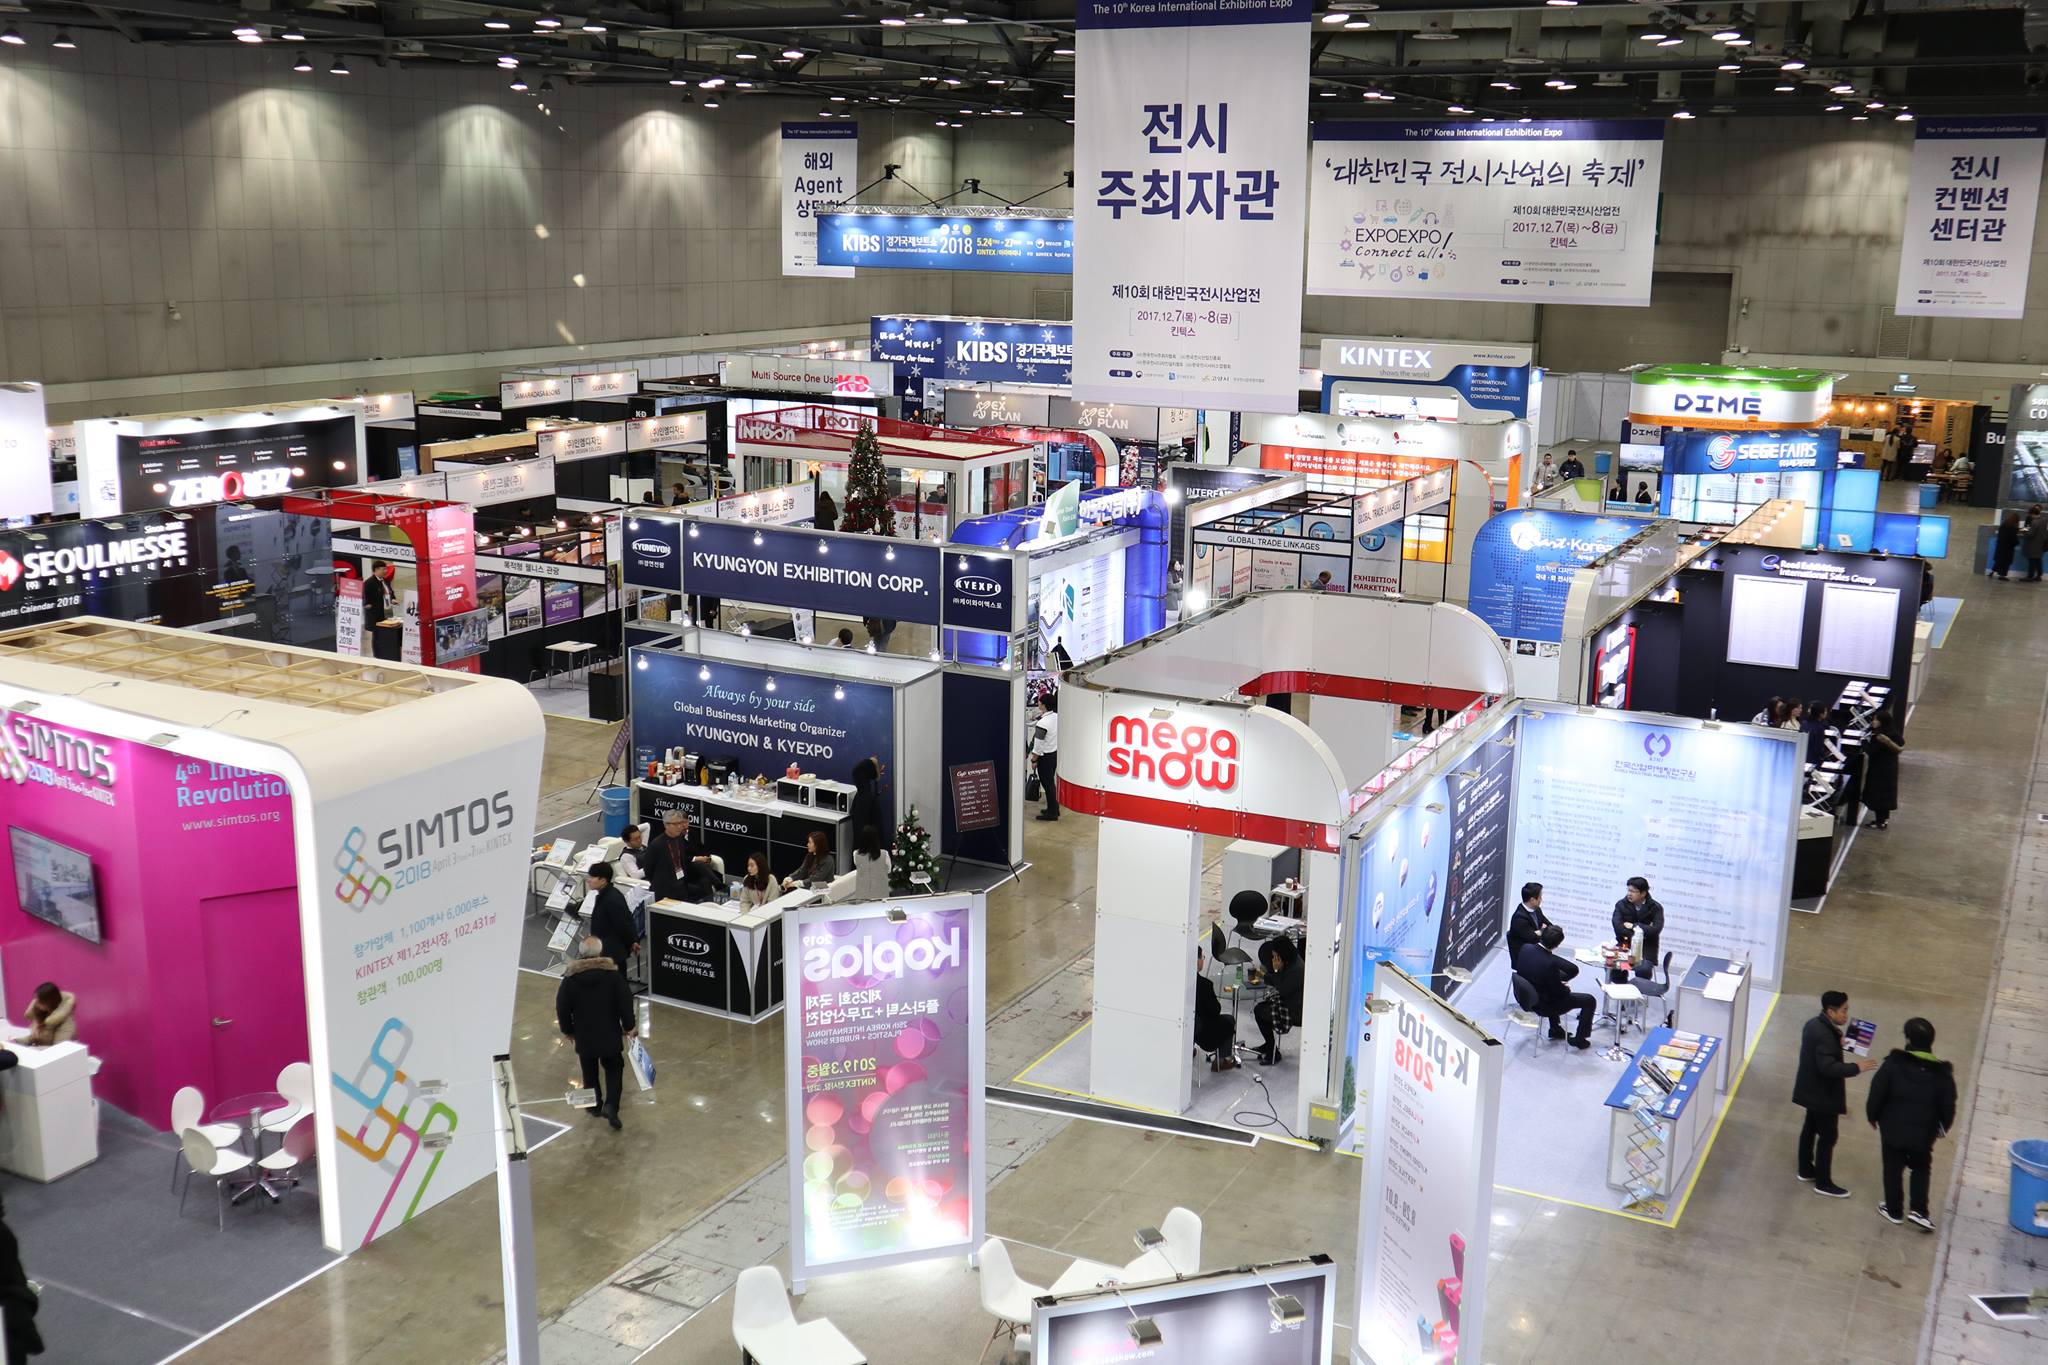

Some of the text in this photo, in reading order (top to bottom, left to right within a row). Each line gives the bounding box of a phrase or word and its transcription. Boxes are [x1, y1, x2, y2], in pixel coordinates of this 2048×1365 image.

[1093, 4, 1109, 14] The
[1130, 3, 1155, 13] Korea
[1158, 0, 1217, 11] International
[1219, 0, 1267, 10] Exhibition
[1269, 0, 1293, 9] Expo
[1141, 103, 1228, 154] 전시
[1405, 129, 1418, 137] The
[1434, 129, 1454, 137] Korea
[1456, 129, 1503, 137] International
[1504, 129, 1542, 138] Exhibition
[1544, 129, 1563, 139] Expo
[804, 152, 833, 171] 해외
[1950, 156, 2000, 181] 전시
[1440, 158, 1571, 187] 전시산업의
[795, 177, 843, 196] Agent
[1097, 169, 1280, 220] 주최자관
[1935, 187, 2009, 211] 컨벤션
[1513, 206, 1620, 216] 제10회 대한민국전시산업전
[1512, 221, 1580, 234] 2017.12.7(목)
[1930, 218, 2007, 242] 센터관
[842, 234, 881, 253] KIBS
[886, 236, 938, 247] 경기국제보트쇼
[940, 237, 973, 255] 2018
[1550, 238, 1578, 248] 킨텍스
[1356, 246, 1412, 258] Connect
[1112, 284, 1261, 303] 제10회 대한민국전시산업전
[1137, 309, 1232, 325] 2017.12.7(목) ~8(금)
[1171, 326, 1196, 337] 킨텍스
[956, 340, 1009, 363] KIBS
[1340, 346, 1432, 369] KINTEX
[752, 371, 839, 385] Multi Source One Use
[1470, 393, 1501, 401] CONVENTION
[1674, 393, 1762, 415] DIME
[992, 401, 1006, 411] EX
[1098, 408, 1113, 418] EX
[992, 412, 1021, 422] PLAN
[1098, 419, 1129, 429] PLAN
[1632, 428, 1661, 437] DIME
[1985, 432, 2006, 445] Bu
[1780, 443, 1818, 458] FAIRS
[762, 503, 780, 516] 웰니스
[783, 498, 795, 510] 관광
[1358, 511, 1371, 525] GLOBAL
[1372, 507, 1384, 517] TRADE
[144, 525, 164, 534] Since
[354, 543, 398, 558] WORLD-EXPO
[632, 541, 672, 555] KYUNGYON
[1227, 536, 1321, 551] GLOBAL TRADE LINKAGES
[24, 533, 188, 580] SEOULMESSE
[504, 560, 560, 576] 목적형 웰니스 관광
[693, 551, 929, 596] KYUNGYON EXHIBITION CORP.
[1781, 560, 1846, 574] Reed Exhibitions
[1354, 575, 1397, 584] EXHIBITION
[1780, 569, 1877, 586] International Sales Group
[956, 578, 1002, 595] KYEXPO
[1353, 583, 1396, 593] MARKETING
[20, 595, 80, 614] Calendar 2018
[702, 685, 816, 713] Always by your side
[673, 701, 847, 739] Global Business Marketing Organizer
[686, 723, 833, 759] KYUNGYON & KYEXPO
[1107, 715, 1238, 760] mega
[14, 718, 113, 787] SIMTOS
[175, 763, 201, 784] 4th
[1107, 747, 1238, 791] show
[654, 798, 695, 813] Since 1982
[182, 810, 281, 832] www.simtos.org
[705, 818, 748, 834] & KYEXPO
[378, 790, 514, 870] SIMTOS
[394, 833, 513, 890] 2018 April KINTEX
[353, 895, 489, 958] 참가업체 1,100개사 6,000부스
[667, 936, 710, 953] KYEXPO
[355, 955, 394, 981] KINTEX
[397, 932, 451, 962] 제1,2전시장,
[671, 956, 698, 966] EXPOSITION
[357, 958, 443, 1006] 참관객 100,000명
